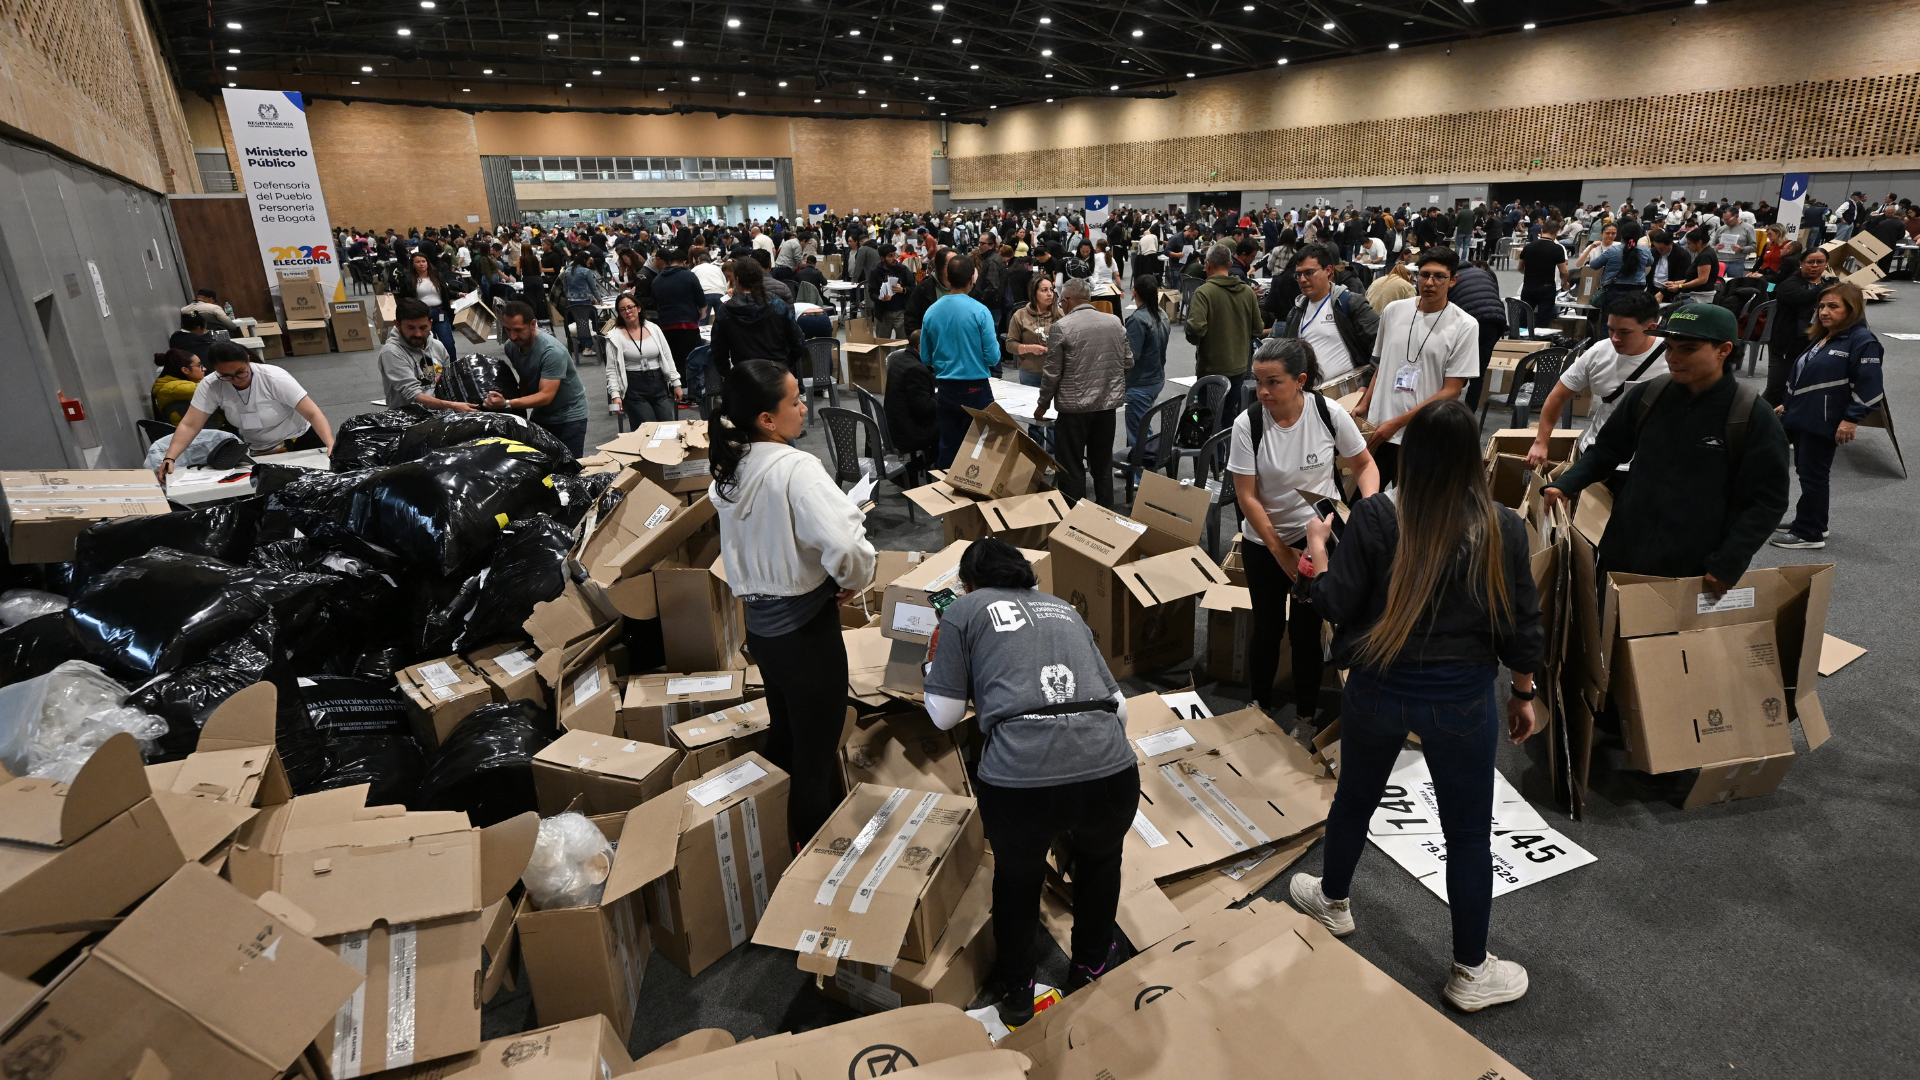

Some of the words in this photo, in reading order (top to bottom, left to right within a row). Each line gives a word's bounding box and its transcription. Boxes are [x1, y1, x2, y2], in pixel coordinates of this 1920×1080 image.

[245, 146, 308, 157] Ministerio
[247, 158, 296, 168] Público
[253, 181, 310, 190] Defensoría
[256, 192, 273, 201] del
[275, 192, 313, 201] Pueblo
[258, 203, 315, 212] Personería
[261, 214, 275, 223] de
[277, 213, 316, 224] Bogotá
[1088, 222, 1102, 230] Salid
[268, 245, 331, 261] 2026
[273, 258, 332, 267] ELECCIONES
[1036, 613, 1075, 624] ELECTORAL
[330, 698, 364, 706] VOTACIÓN
[1378, 785, 1429, 830] 140
